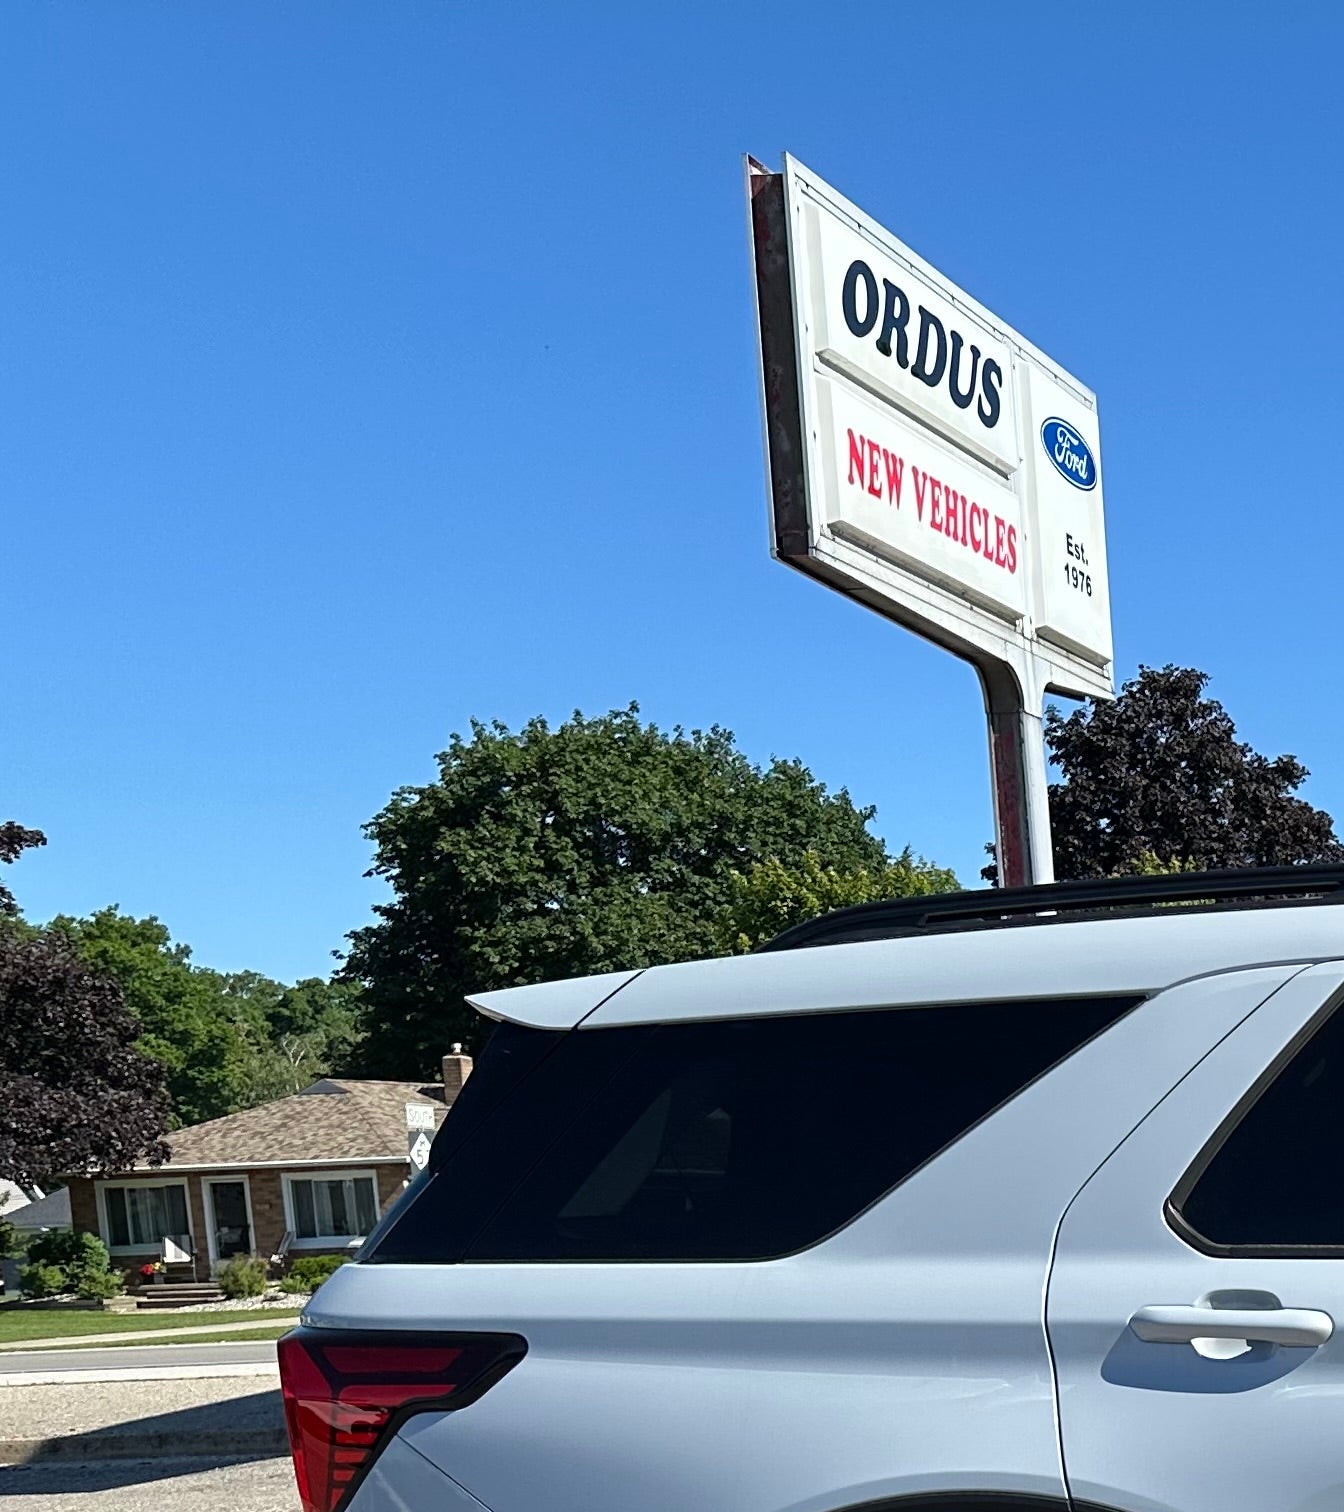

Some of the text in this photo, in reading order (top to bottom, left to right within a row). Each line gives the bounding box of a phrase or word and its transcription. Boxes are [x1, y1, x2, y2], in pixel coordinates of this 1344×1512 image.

[842, 260, 1002, 428] ORDUS
[1053, 425, 1089, 481] Ford
[847, 428, 1017, 574] NEW VEHICLES
[1066, 532, 1089, 565] Est.
[1064, 562, 1092, 597] 1976
